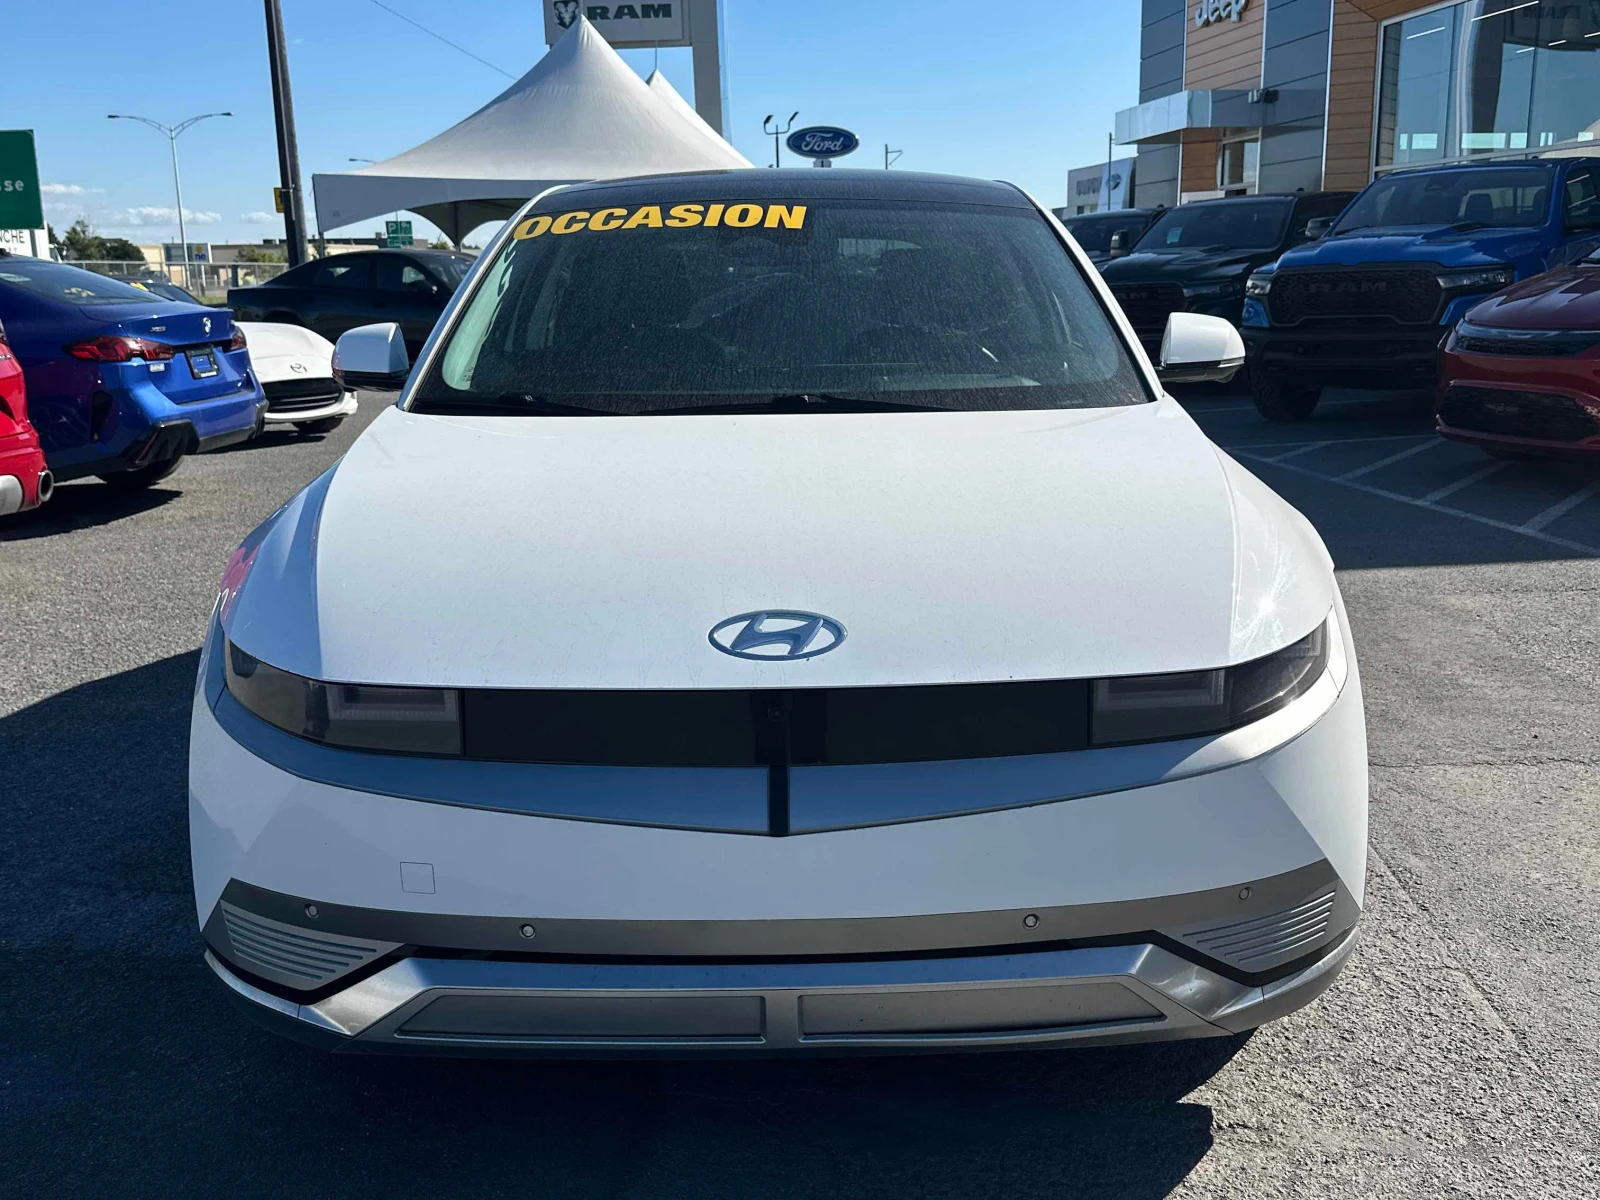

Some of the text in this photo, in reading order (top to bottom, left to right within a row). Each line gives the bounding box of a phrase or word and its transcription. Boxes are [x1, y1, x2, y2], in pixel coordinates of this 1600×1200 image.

[587, 4, 672, 20] RAM
[1195, 0, 1246, 26] Jeep
[801, 132, 844, 151] Ford
[0, 180, 24, 191] se
[388, 223, 396, 233] P
[513, 204, 807, 240] OCCASION
[1309, 281, 1387, 293] RAM
[1116, 292, 1148, 300] AM
